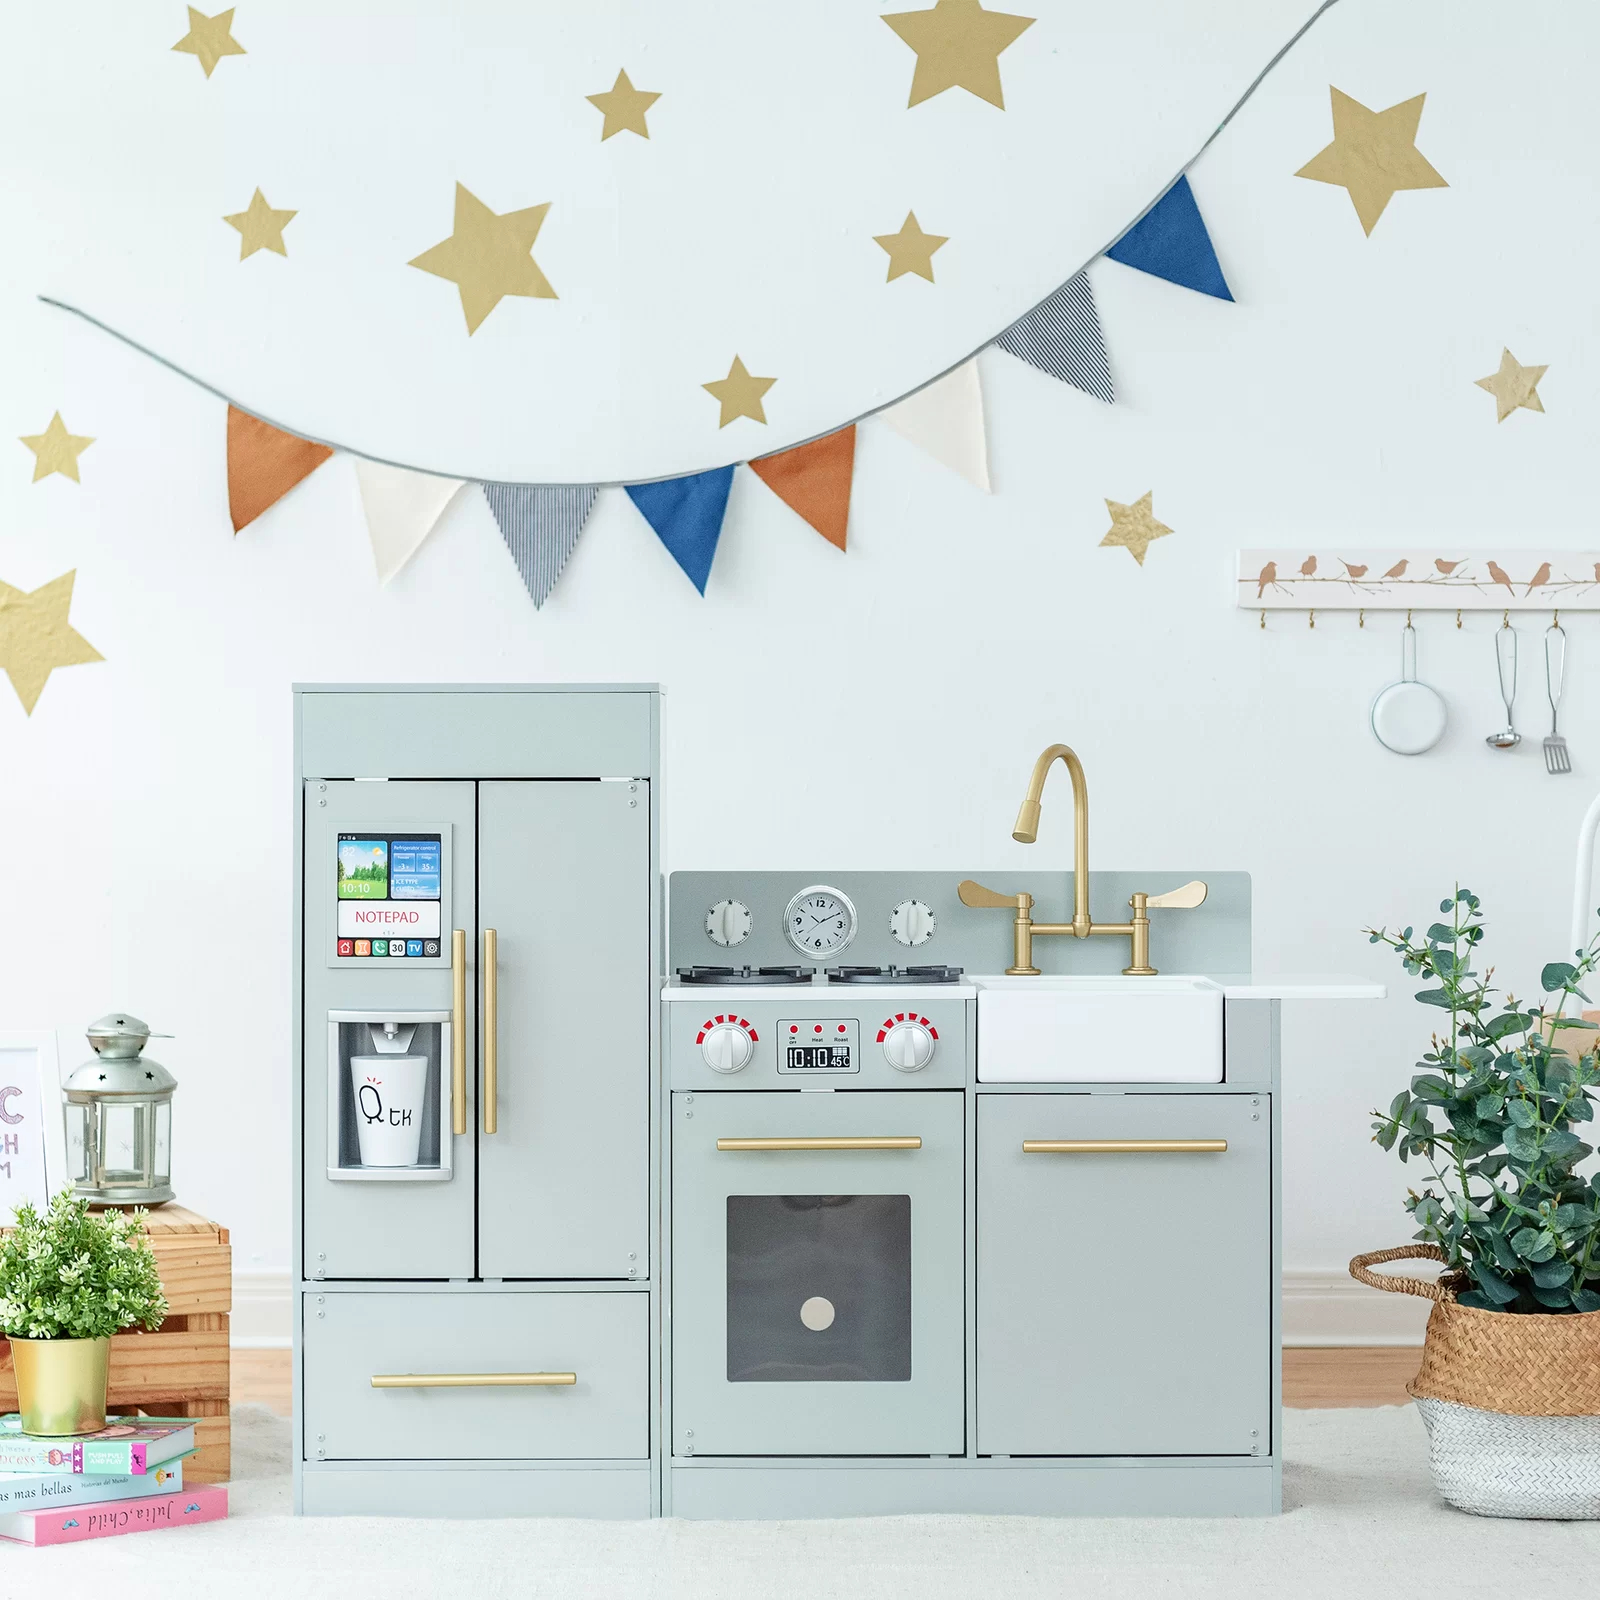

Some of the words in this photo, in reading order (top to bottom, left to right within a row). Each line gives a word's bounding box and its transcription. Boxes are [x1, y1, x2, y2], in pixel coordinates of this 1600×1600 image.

[341, 883, 370, 893] 10:10
[816, 899, 826, 908] 12
[355, 911, 419, 923] NOTEPAD
[795, 917, 802, 925] 9
[836, 920, 843, 929] 3
[814, 938, 822, 947] 6
[392, 944, 404, 953] 30
[409, 944, 421, 952] TV
[789, 1048, 828, 1067] 10:10
[14, 1489, 36, 1500] mas
[41, 1480, 72, 1497] bellas
